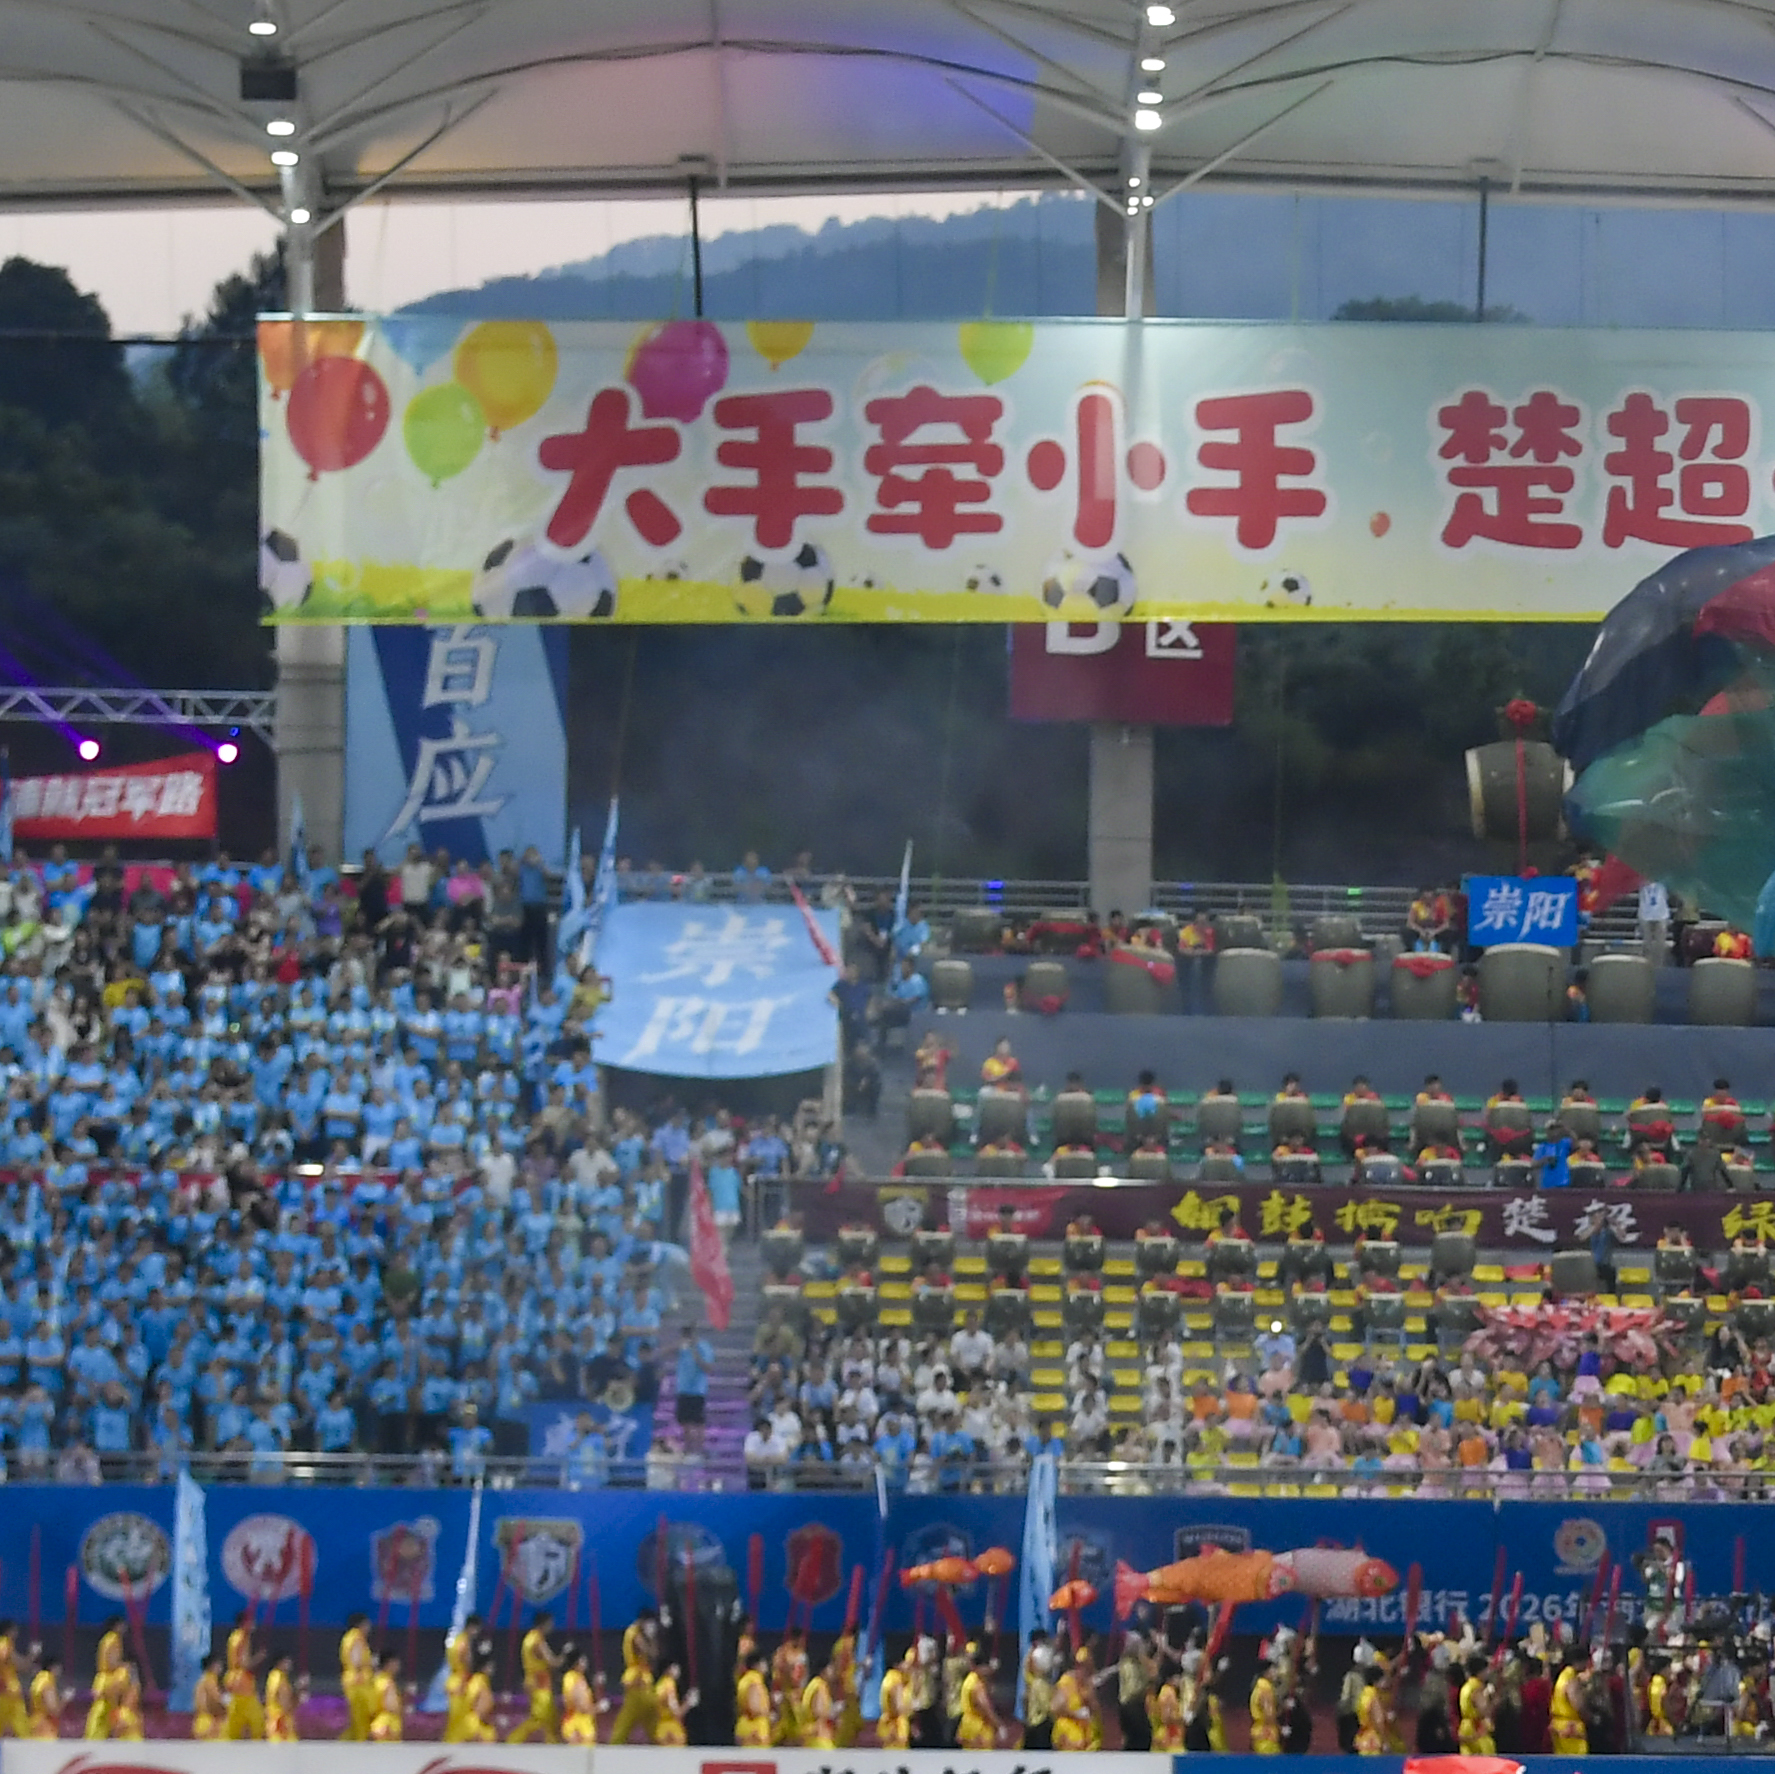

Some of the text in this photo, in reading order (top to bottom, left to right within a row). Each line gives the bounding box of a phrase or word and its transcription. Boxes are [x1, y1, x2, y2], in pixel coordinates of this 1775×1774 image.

[537, 386, 1327, 551] 大手牵小手
[1472, 881, 1574, 941] 崇阳
